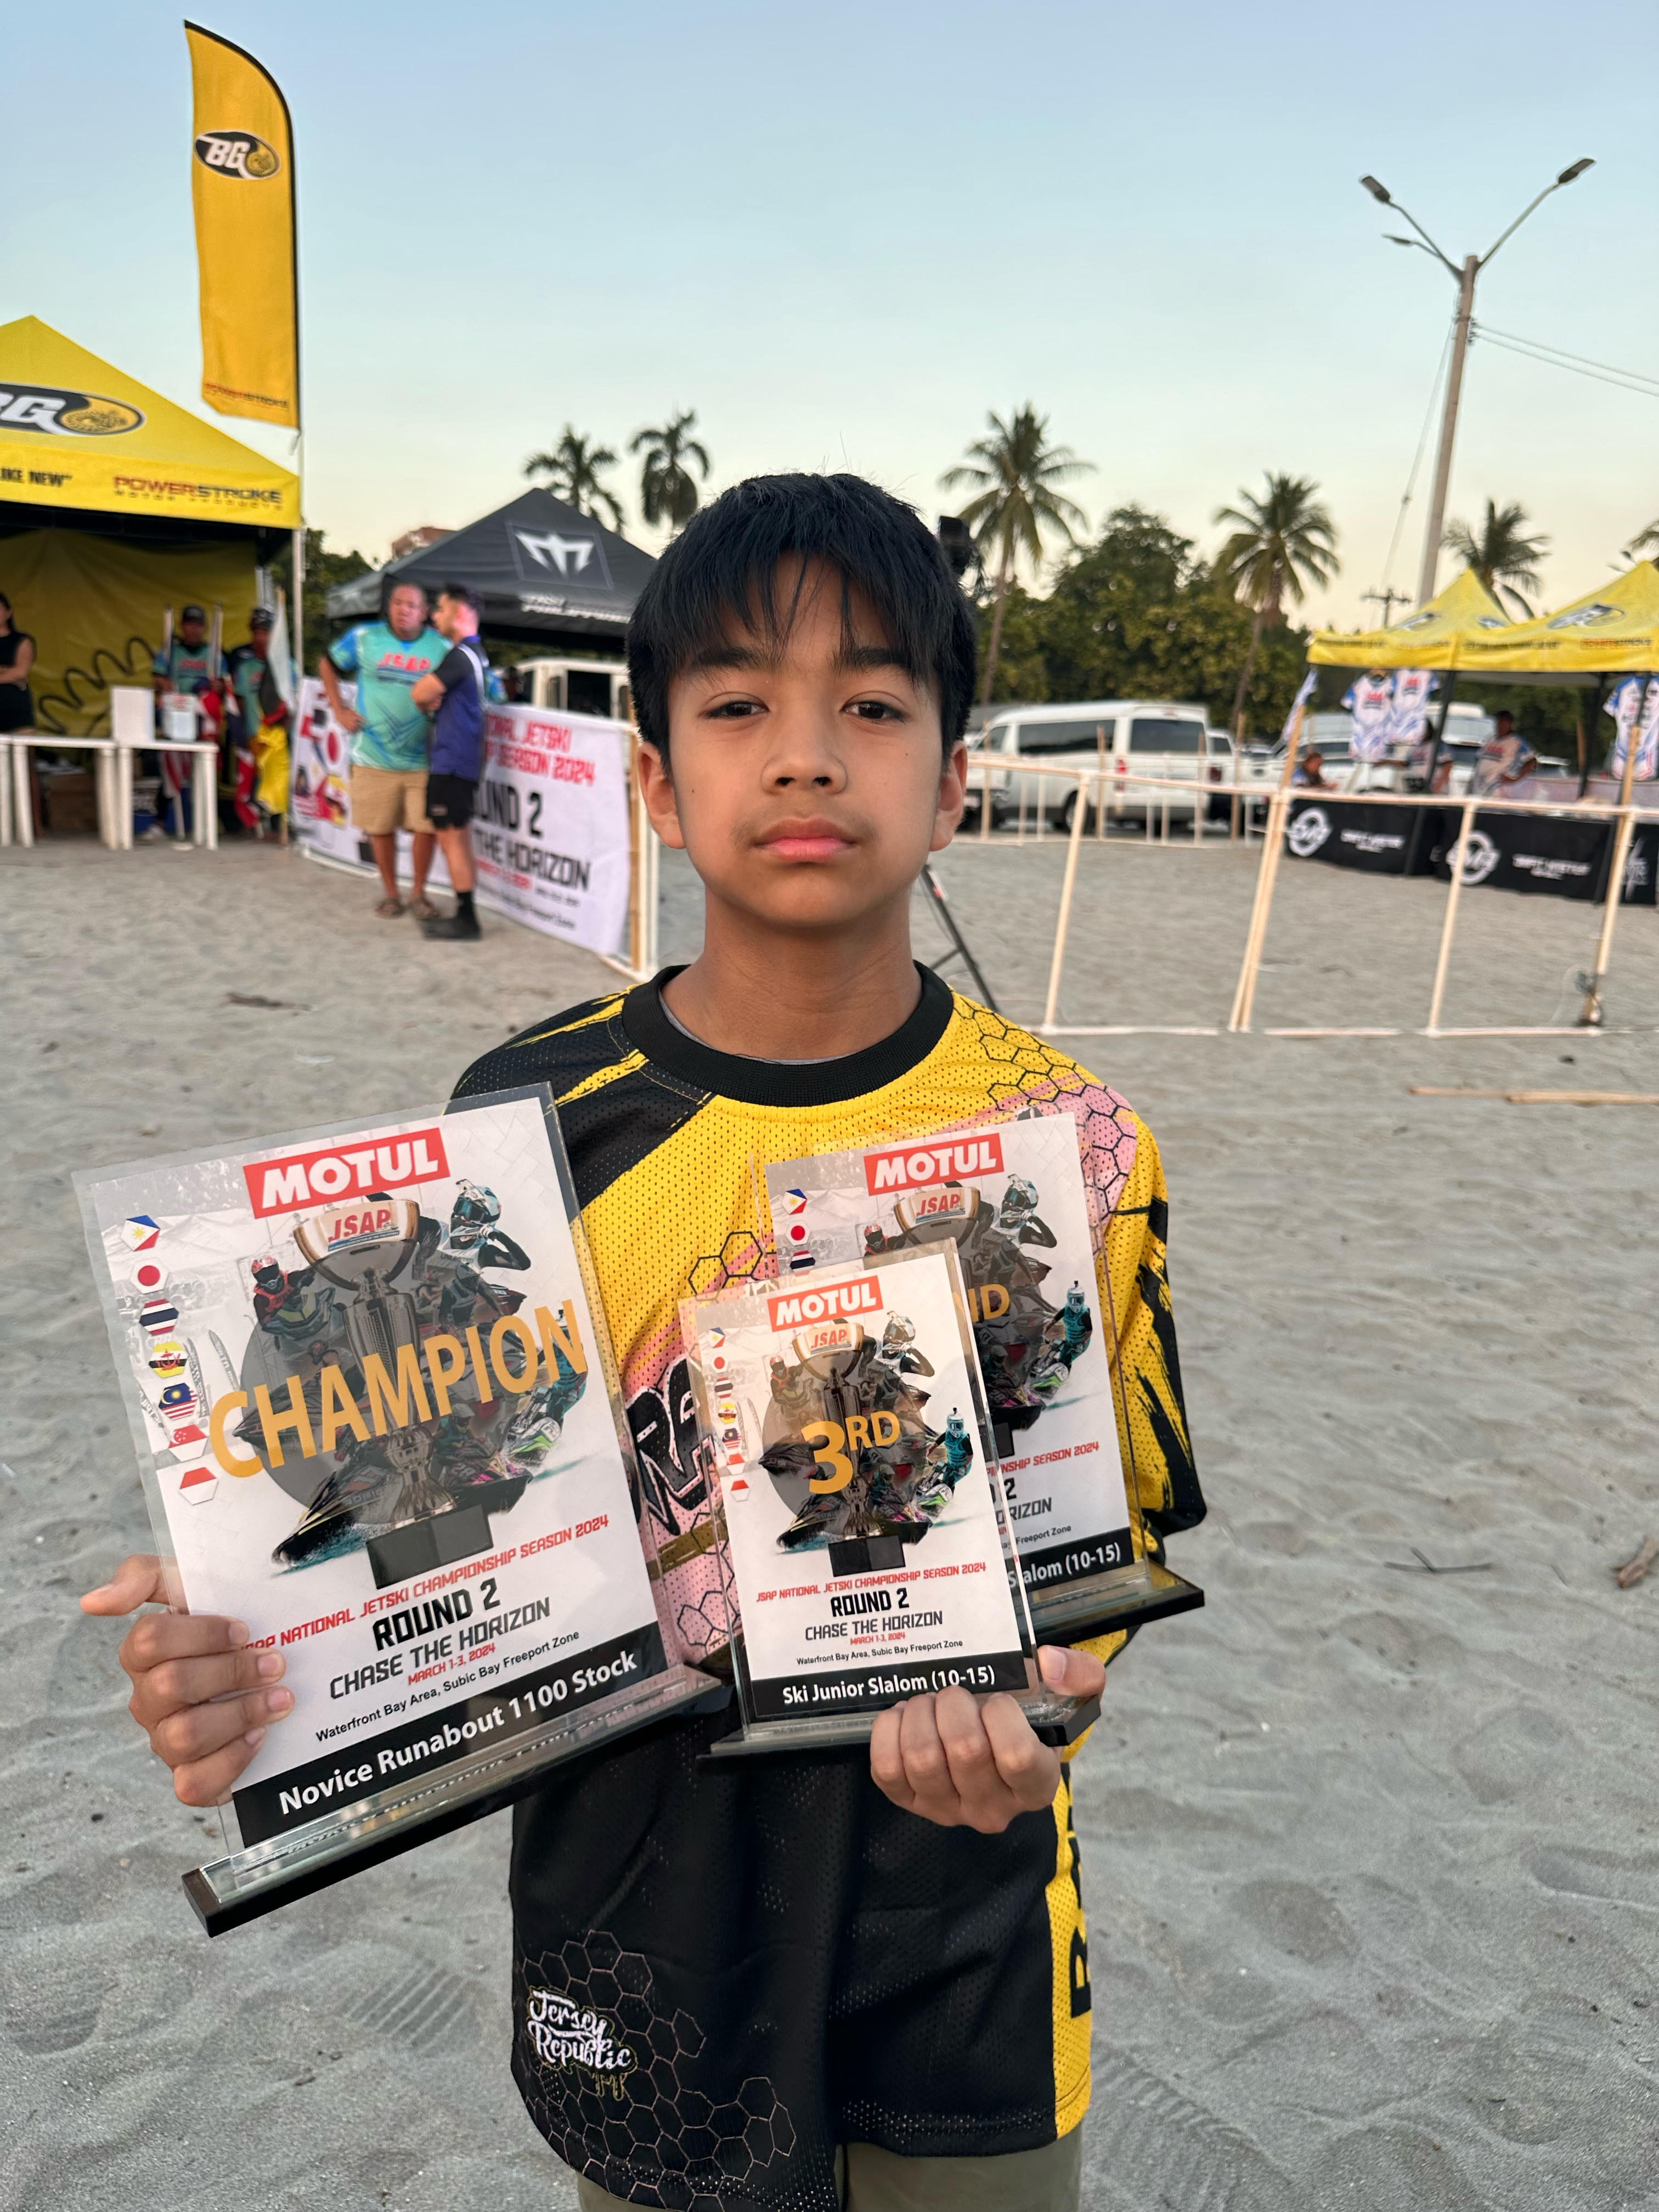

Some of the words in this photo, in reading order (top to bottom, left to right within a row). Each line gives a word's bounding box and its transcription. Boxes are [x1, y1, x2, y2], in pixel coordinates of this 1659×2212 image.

[114, 476, 283, 504] POWERSTROKE
[552, 754, 596, 788] 2024
[475, 778, 520, 832] UND
[527, 790, 544, 838] 2
[506, 839, 591, 893] HORIZON
[262, 1138, 438, 1209] MOTUL
[874, 1141, 996, 1189] MOTUL
[328, 1209, 391, 1243] JSAP
[916, 1194, 960, 1216] JSAP
[776, 1283, 876, 1326] MOTUL
[811, 1329, 847, 1349] JSAP
[209, 1299, 588, 1478] CHAMPION
[802, 1410, 900, 1494] 3RD
[1034, 1448, 1071, 1466] SEASON
[1074, 1441, 1099, 1456] 2024
[1003, 1477, 1017, 1500] 2
[996, 1497, 1052, 1525] ORIZON
[1016, 1530, 1050, 1545] Freeport
[1052, 1525, 1071, 1536] Zone
[280, 1608, 356, 1646] NATIONAL
[360, 1587, 409, 1618] JETSKI
[413, 1548, 516, 1598] CHAMPIONSHIP
[521, 1527, 572, 1559] SEASON
[575, 1514, 609, 1538] 2024
[757, 1590, 777, 1602] JSAP
[779, 1584, 821, 1599] NATIONAL
[823, 1580, 853, 1593] JETSKI
[855, 1571, 921, 1589] CHAMPIONSHIP
[923, 1566, 959, 1579] SEASON
[962, 1562, 986, 1574] 2024
[1008, 1559, 1062, 1588] Salom
[1065, 1542, 1121, 1575] (10-15)
[373, 1589, 473, 1651] ROUND
[481, 1577, 501, 1610] 2
[831, 1590, 891, 1617] ROUND
[896, 1587, 910, 1609] 2
[330, 1654, 403, 1699] CHASE
[410, 1635, 453, 1668] THE
[459, 1596, 550, 1651] HORIZON
[805, 1622, 848, 1641] CHASE
[852, 1618, 878, 1635] THE
[882, 1611, 943, 1631] HORIZON
[850, 1635, 874, 1645] MARCH
[888, 1632, 906, 1641] 2024
[408, 1661, 446, 1685] MARCH
[449, 1655, 466, 1669] 1-3,
[469, 1642, 496, 1662] 2024
[797, 1655, 834, 1665] Waterfront
[836, 1653, 849, 1661] Bay
[851, 1651, 870, 1659] Area,
[872, 1647, 893, 1657] Subic
[895, 1646, 909, 1655] Bay
[911, 1641, 943, 1652] Freeport
[316, 1708, 382, 1742] Waterfront
[384, 1700, 407, 1716] Bay
[410, 1688, 441, 1706] Area,
[443, 1672, 476, 1691] Subic
[479, 1662, 500, 1678] Bay
[503, 1641, 550, 1668] Freeport
[552, 1631, 579, 1649] Zone
[783, 1684, 808, 1704] Ski
[812, 1681, 865, 1701] Junior
[868, 1673, 928, 1695] Slalom
[931, 1664, 996, 1691] (10-15)
[279, 1762, 374, 1815] Novice
[376, 1706, 505, 1775] Runabout
[509, 1679, 568, 1718] 1100
[572, 1650, 638, 1694] Stock
[529, 1990, 607, 2036] Jersey
[527, 2020, 631, 2070] Republic
